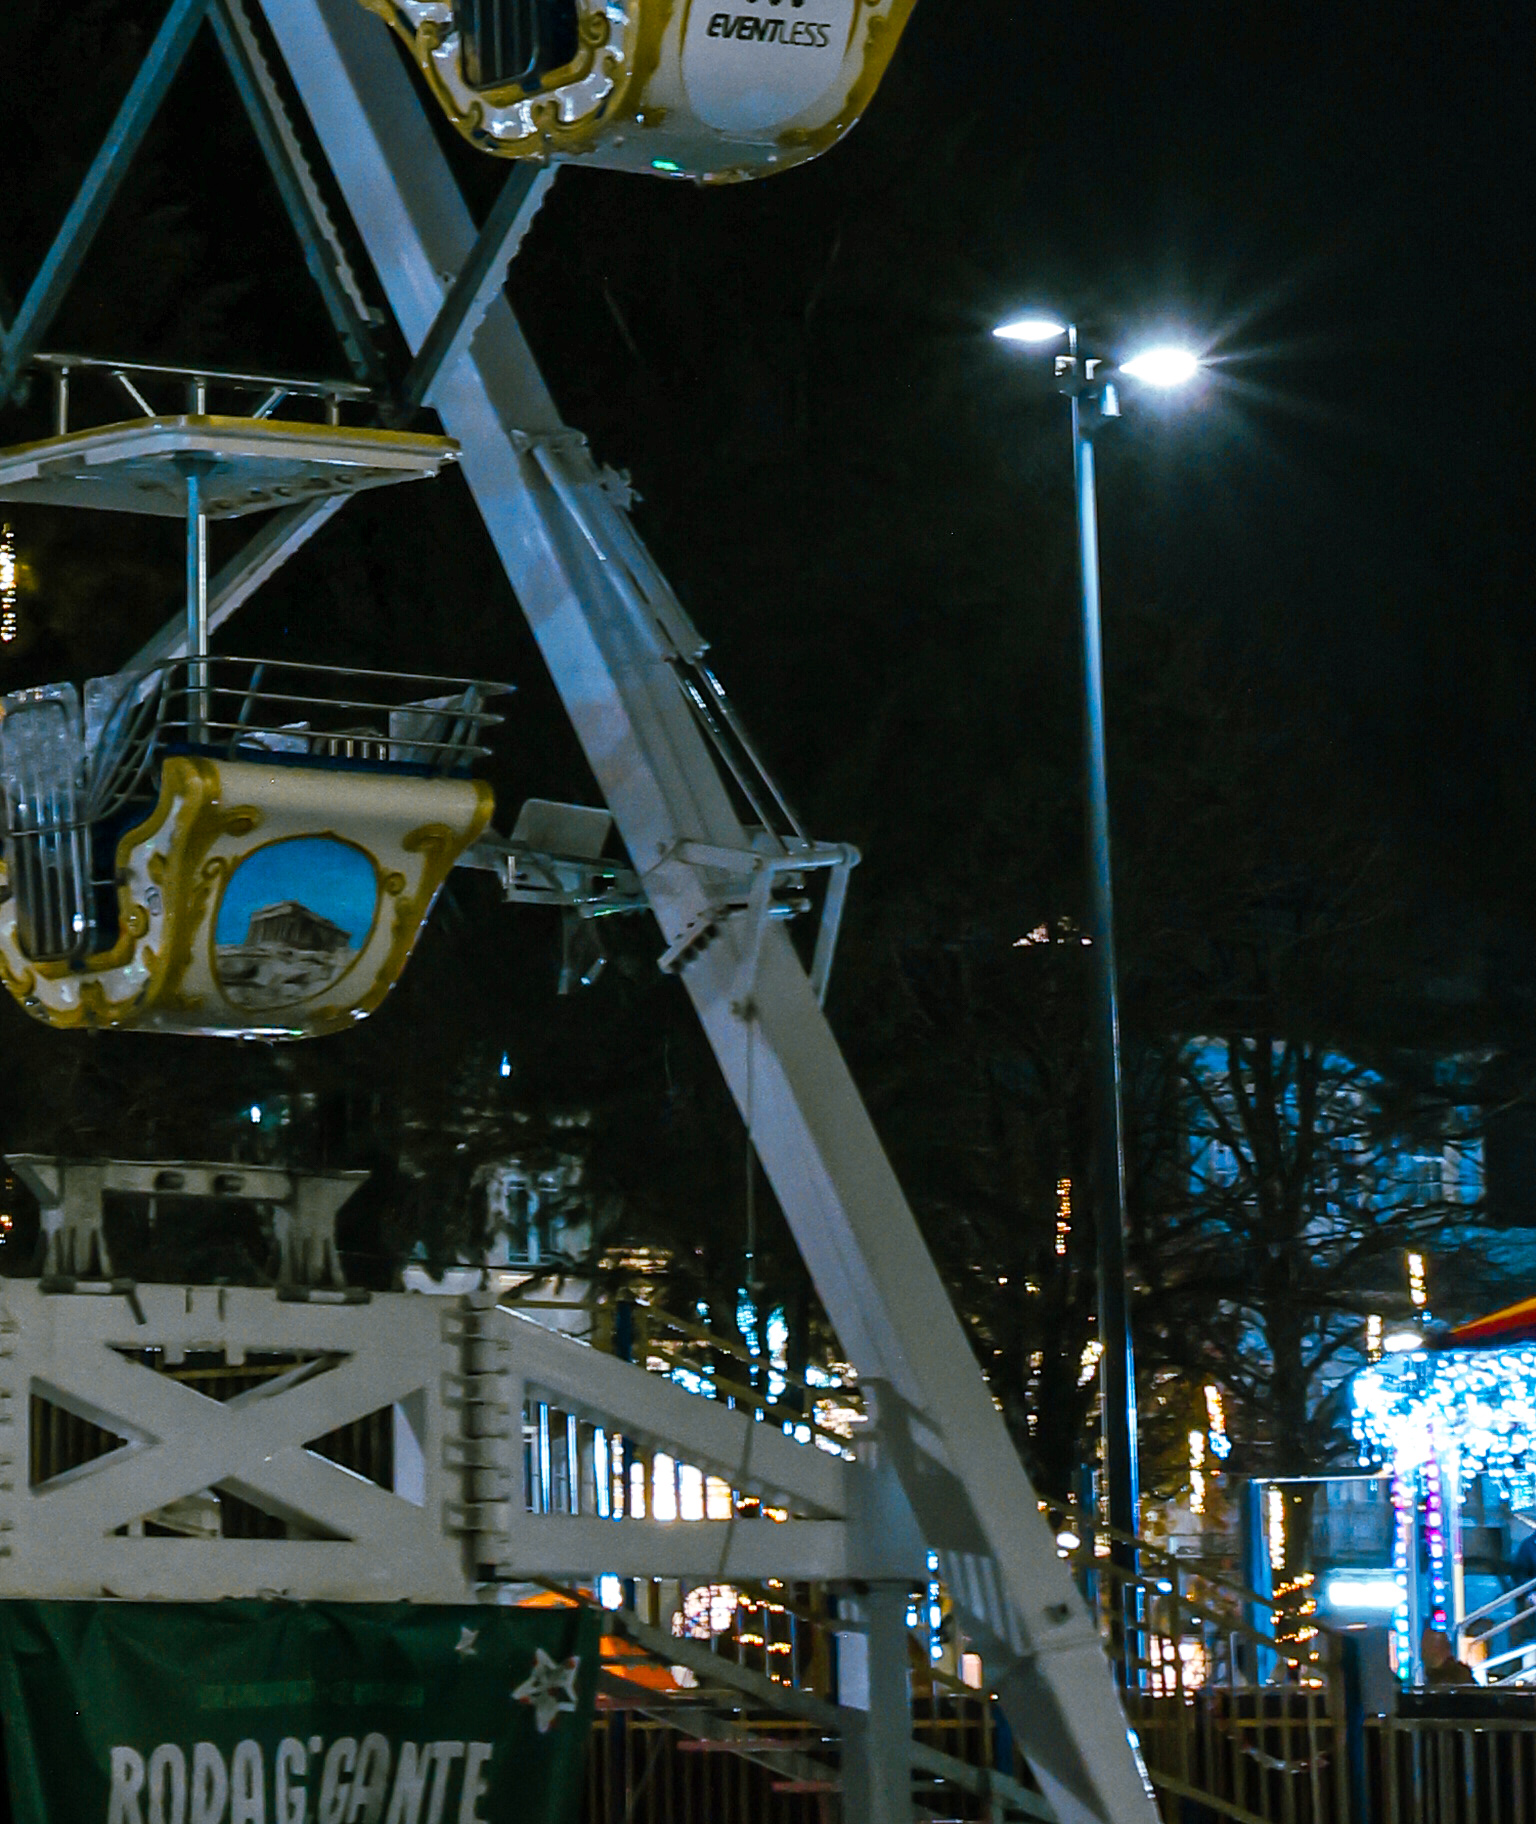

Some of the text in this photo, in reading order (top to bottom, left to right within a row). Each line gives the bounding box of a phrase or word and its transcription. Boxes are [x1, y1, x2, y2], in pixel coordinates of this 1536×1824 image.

[706, 12, 832, 48] EVENTLESS
[106, 1732, 494, 1824] RODA GGANTE
